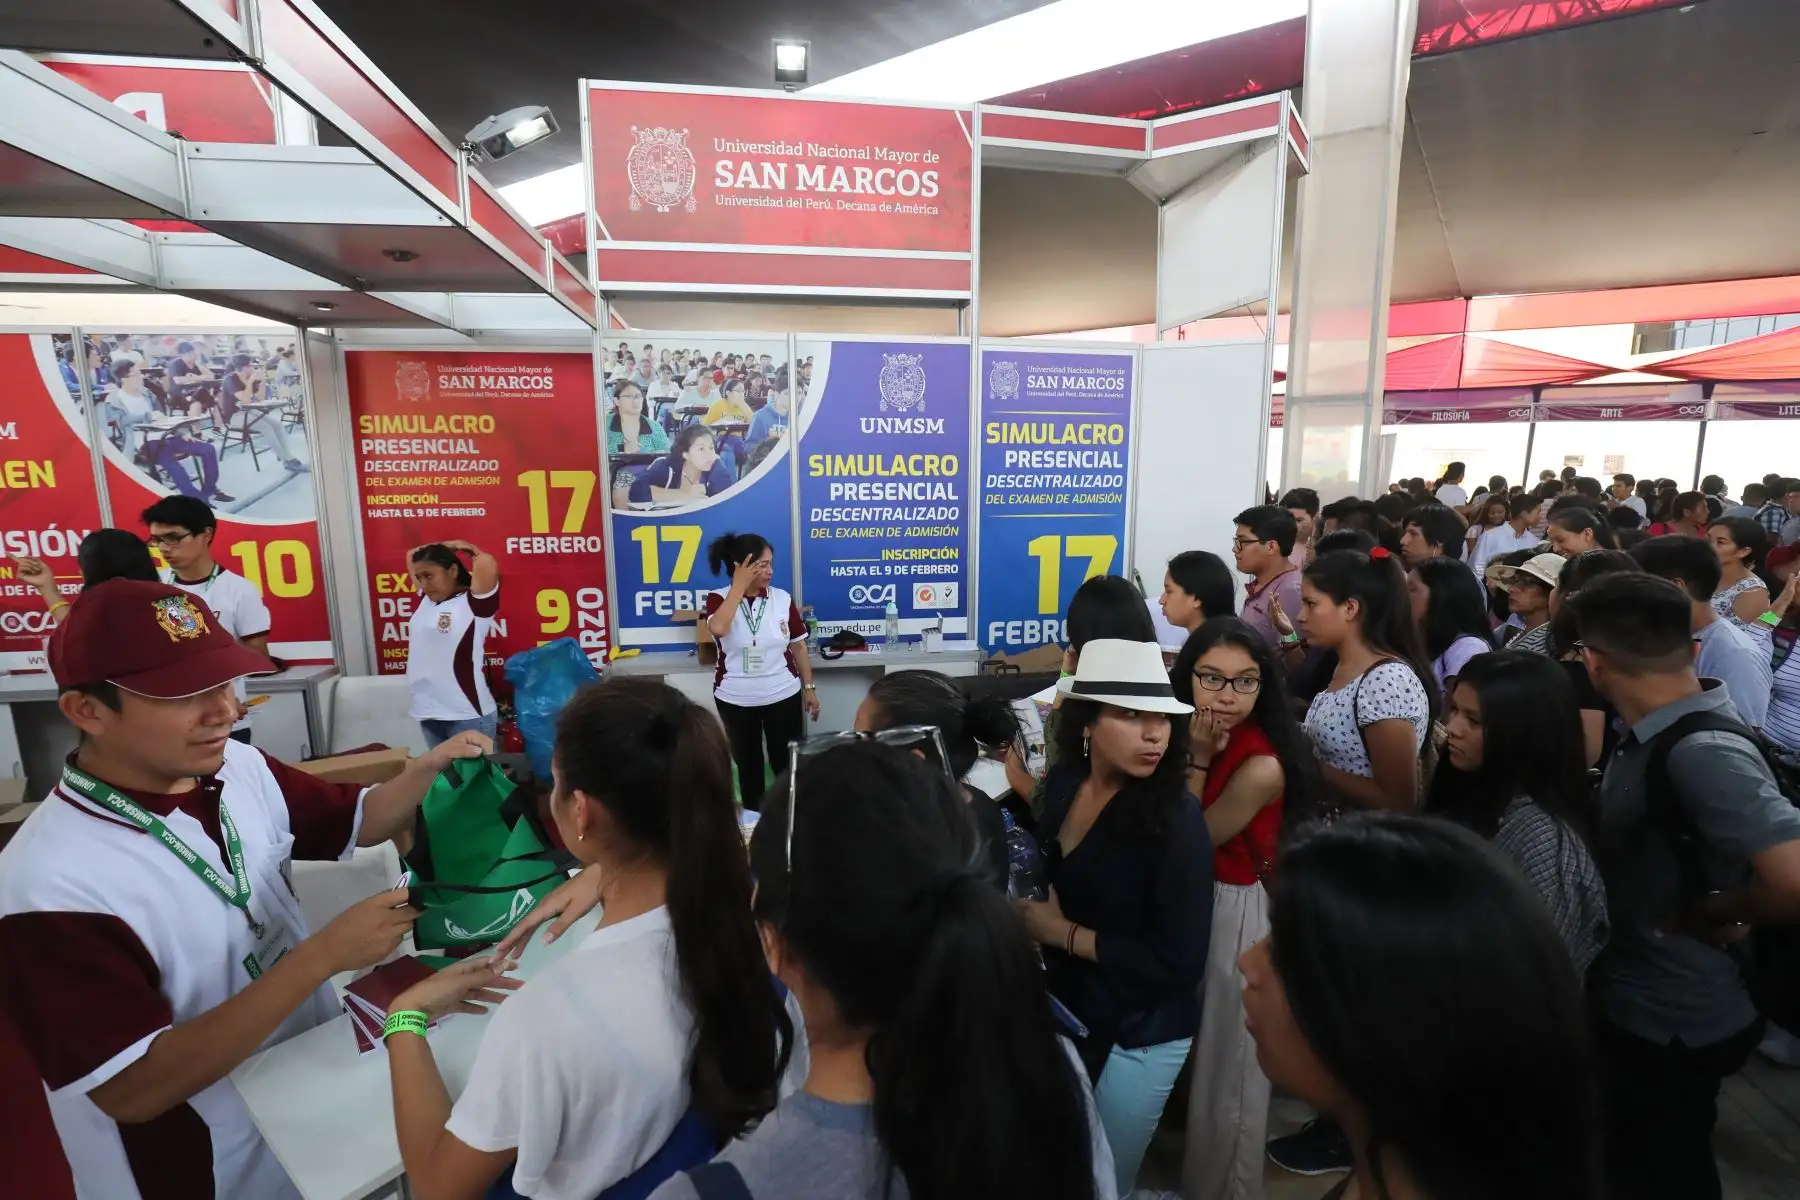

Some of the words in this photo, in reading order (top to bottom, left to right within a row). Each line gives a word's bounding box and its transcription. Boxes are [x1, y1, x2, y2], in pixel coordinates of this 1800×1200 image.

[713, 138, 803, 156] Universidad
[807, 143, 870, 160] Nacional
[874, 147, 919, 164] Mayor
[923, 149, 940, 163] de
[715, 160, 788, 190] SAN
[795, 163, 940, 198] MARCOS
[715, 195, 784, 208] Universidad
[786, 198, 802, 209] del
[837, 200, 877, 213] Decana
[879, 201, 892, 213] de
[895, 202, 939, 215] América
[437, 365, 482, 373] Universidad
[519, 366, 543, 375] Mayor
[543, 366, 553, 374] de
[1027, 365, 1065, 374] Universidad
[1096, 367, 1117, 376] Mayor
[439, 375, 475, 389] SAN
[479, 375, 553, 390] MARCOS
[1027, 375, 1059, 389] SAN
[1062, 376, 1125, 390] MARCOS
[1432, 410, 1470, 421] FILOSOFÍA
[1508, 409, 1530, 417] OCA
[1600, 408, 1624, 418] ARTE
[1679, 405, 1704, 415] OCA
[359, 414, 496, 434] SIMULACRO
[860, 417, 945, 435] UNMSM
[986, 422, 1124, 445] SIMULACRO
[361, 438, 480, 455] PRESENCIAL
[364, 459, 499, 473] DESCENTRALIZADO
[808, 454, 959, 477] SIMULACRO
[1005, 450, 1123, 468] PRESENCIAL
[366, 477, 385, 487] DEL
[388, 476, 432, 487] EXAMEN
[434, 476, 448, 486] DE
[450, 475, 500, 485] ADMISIÓN
[986, 474, 1123, 488] DESCENTRALIZADO
[366, 492, 439, 505] INSCRIPCIÓN
[830, 482, 959, 501] PRESENCIAL
[985, 494, 1006, 505] DEL
[1008, 494, 1054, 504] EXAMEN
[1055, 493, 1069, 504] DE
[1071, 492, 1122, 503] ADMISIÓN
[518, 470, 596, 534] 17
[368, 508, 402, 518] HASTA
[403, 508, 416, 517] EL
[417, 508, 424, 517] 9
[426, 508, 439, 517] DE
[441, 507, 486, 517] FEBRERO
[810, 506, 960, 522] DESCENTRALIZADO
[810, 528, 832, 539] DEL
[836, 527, 884, 538] EXAMEN
[886, 527, 901, 537] DE
[904, 525, 959, 537] ADMISIÓN
[506, 536, 602, 554] FEBRERO
[881, 546, 959, 561] INSCRIPCIÓN
[631, 525, 703, 584] 17
[230, 539, 314, 598] 10
[830, 566, 867, 577] HASTA
[870, 565, 883, 576] EL
[884, 565, 891, 575] 9
[894, 565, 909, 575] DE
[911, 564, 959, 575] FEBRERO
[1028, 535, 1118, 615] 17
[4, 584, 25, 597] DE
[849, 584, 896, 604] OCA
[378, 597, 412, 618] DE
[536, 588, 571, 634] 9
[635, 589, 710, 616] FEBR
[576, 587, 607, 669] ARZO
[988, 619, 1070, 646] FEBR
